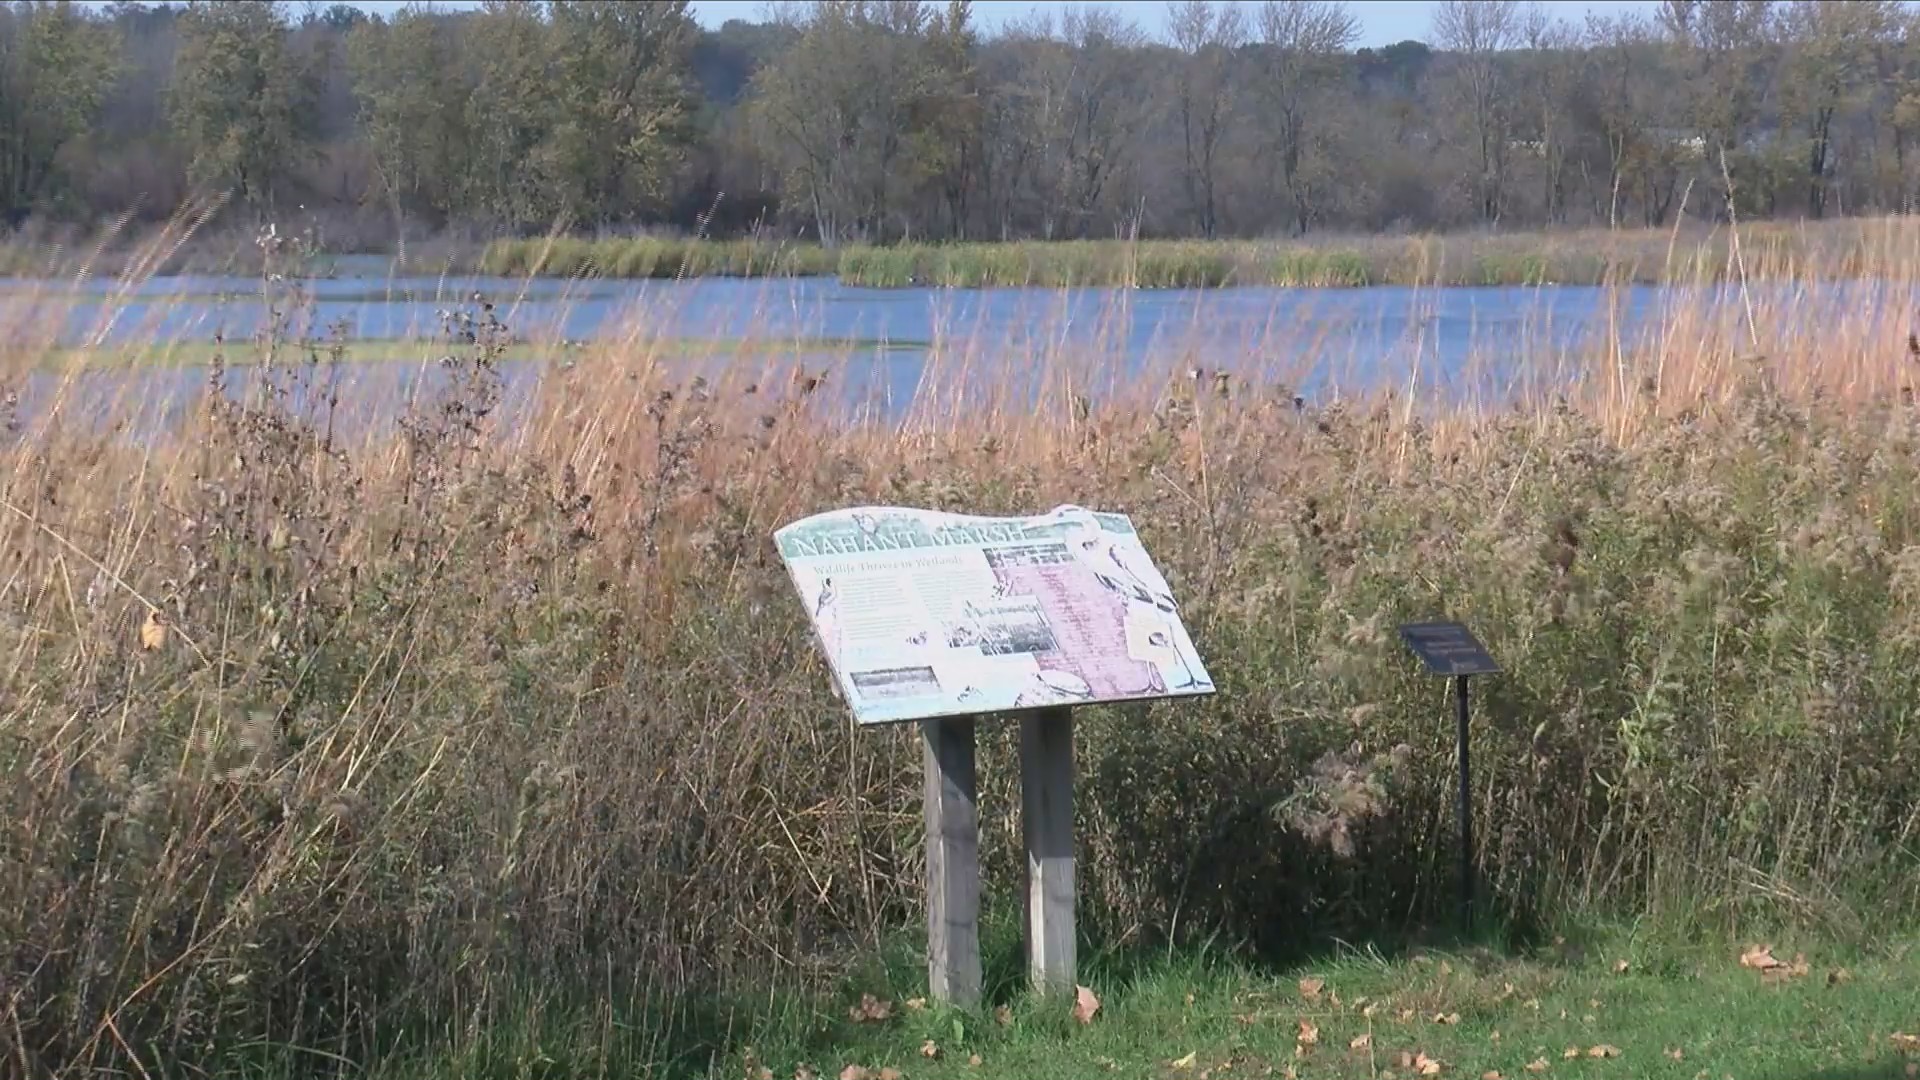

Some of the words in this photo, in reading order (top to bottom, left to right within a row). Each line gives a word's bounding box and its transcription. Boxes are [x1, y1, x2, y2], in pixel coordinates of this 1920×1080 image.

[791, 529, 917, 557] NAHANT
[931, 523, 1029, 547] MARSH
[813, 563, 855, 575] Wildlife
[915, 555, 963, 568] Wetlands
